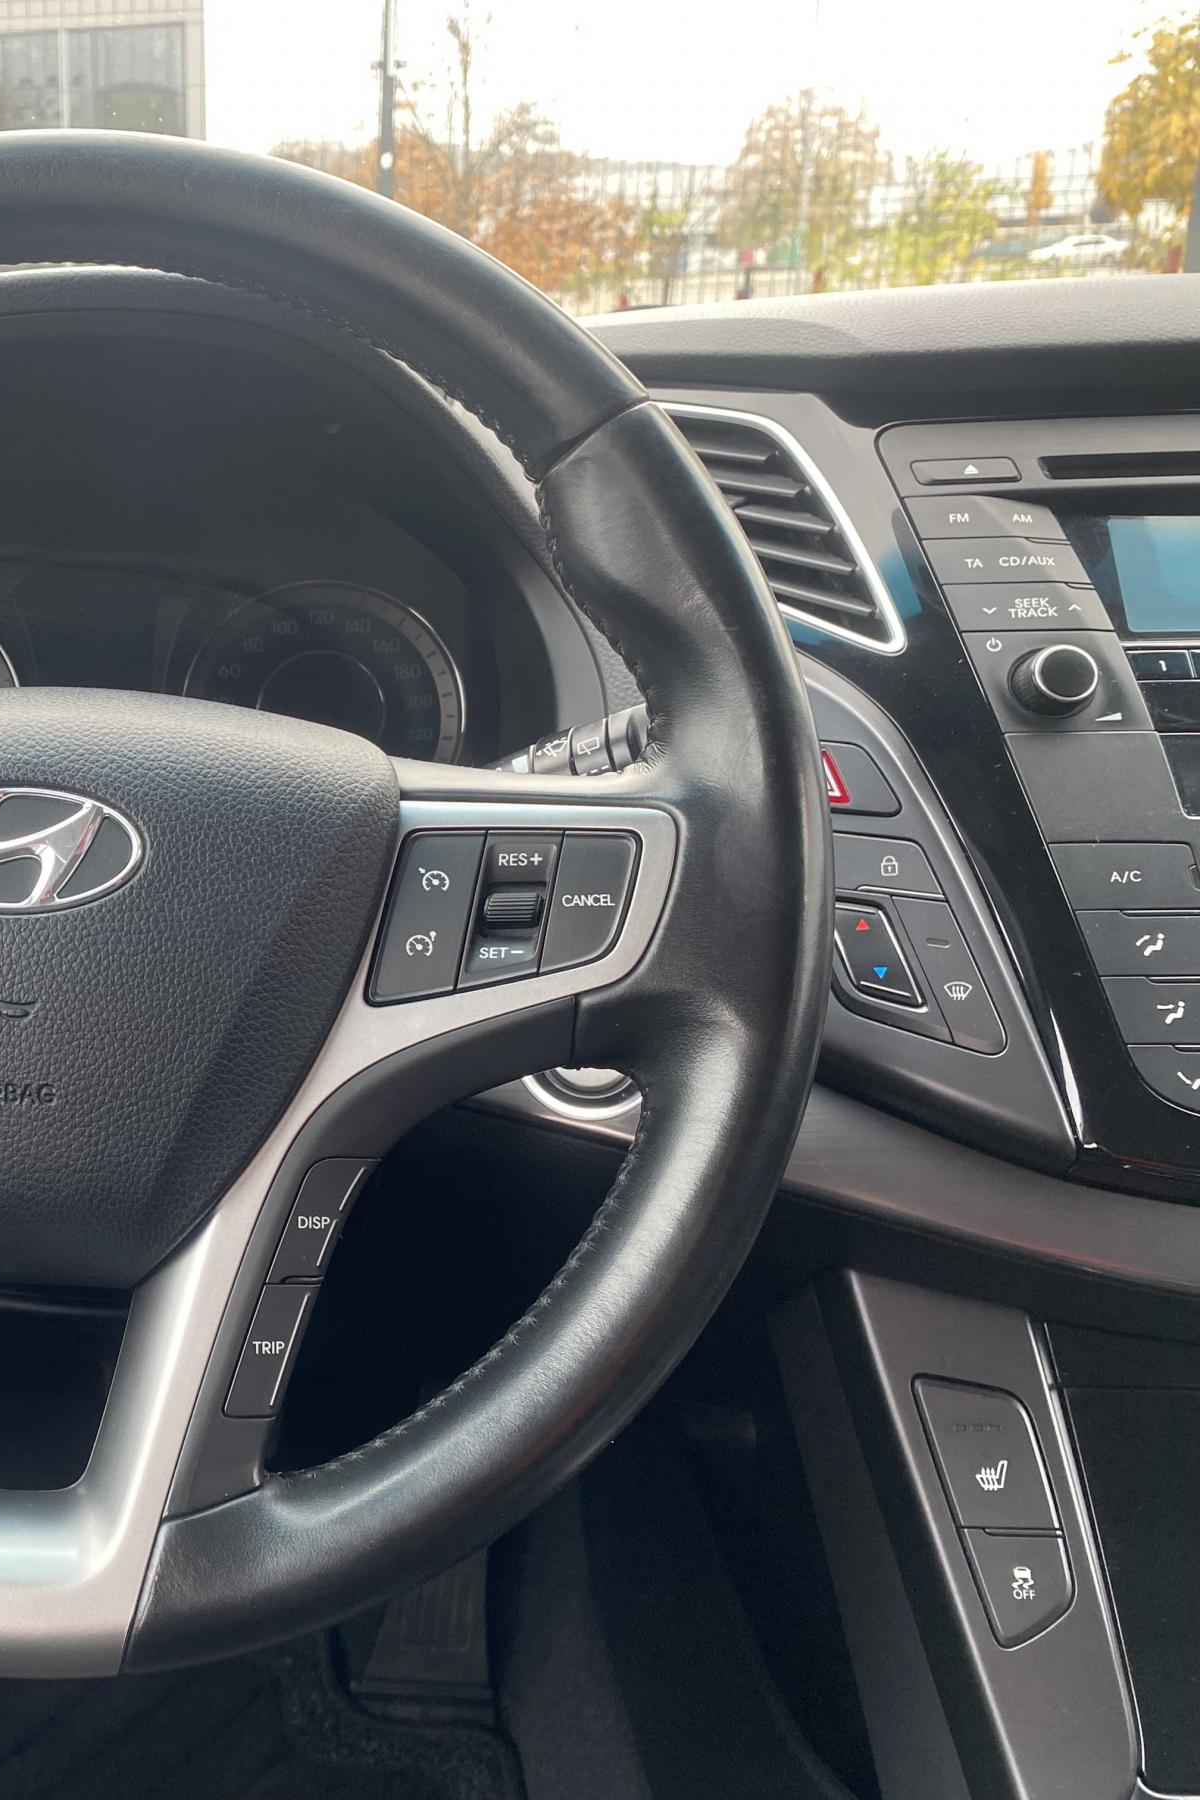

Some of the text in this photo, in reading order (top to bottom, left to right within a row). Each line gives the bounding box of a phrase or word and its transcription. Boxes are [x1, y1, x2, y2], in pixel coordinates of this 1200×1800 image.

[948, 512, 970, 524] FM
[1011, 513, 1033, 524] AM
[964, 558, 984, 569] TA
[998, 555, 1056, 567] CD/AUX
[1014, 597, 1050, 608] SEEK
[309, 610, 335, 625] 120
[1008, 605, 1058, 619] TRACK
[271, 620, 298, 635] 100
[344, 619, 371, 633] 140
[243, 637, 264, 653] 80
[373, 638, 400, 653] 160
[218, 663, 241, 678] 60
[393, 664, 422, 679] 180
[1110, 870, 1142, 883] A/C
[561, 894, 616, 907] CANCEL
[297, 1216, 330, 1229] DISP
[252, 1341, 285, 1355] TRIP
[1012, 1589, 1036, 1600] OFF
